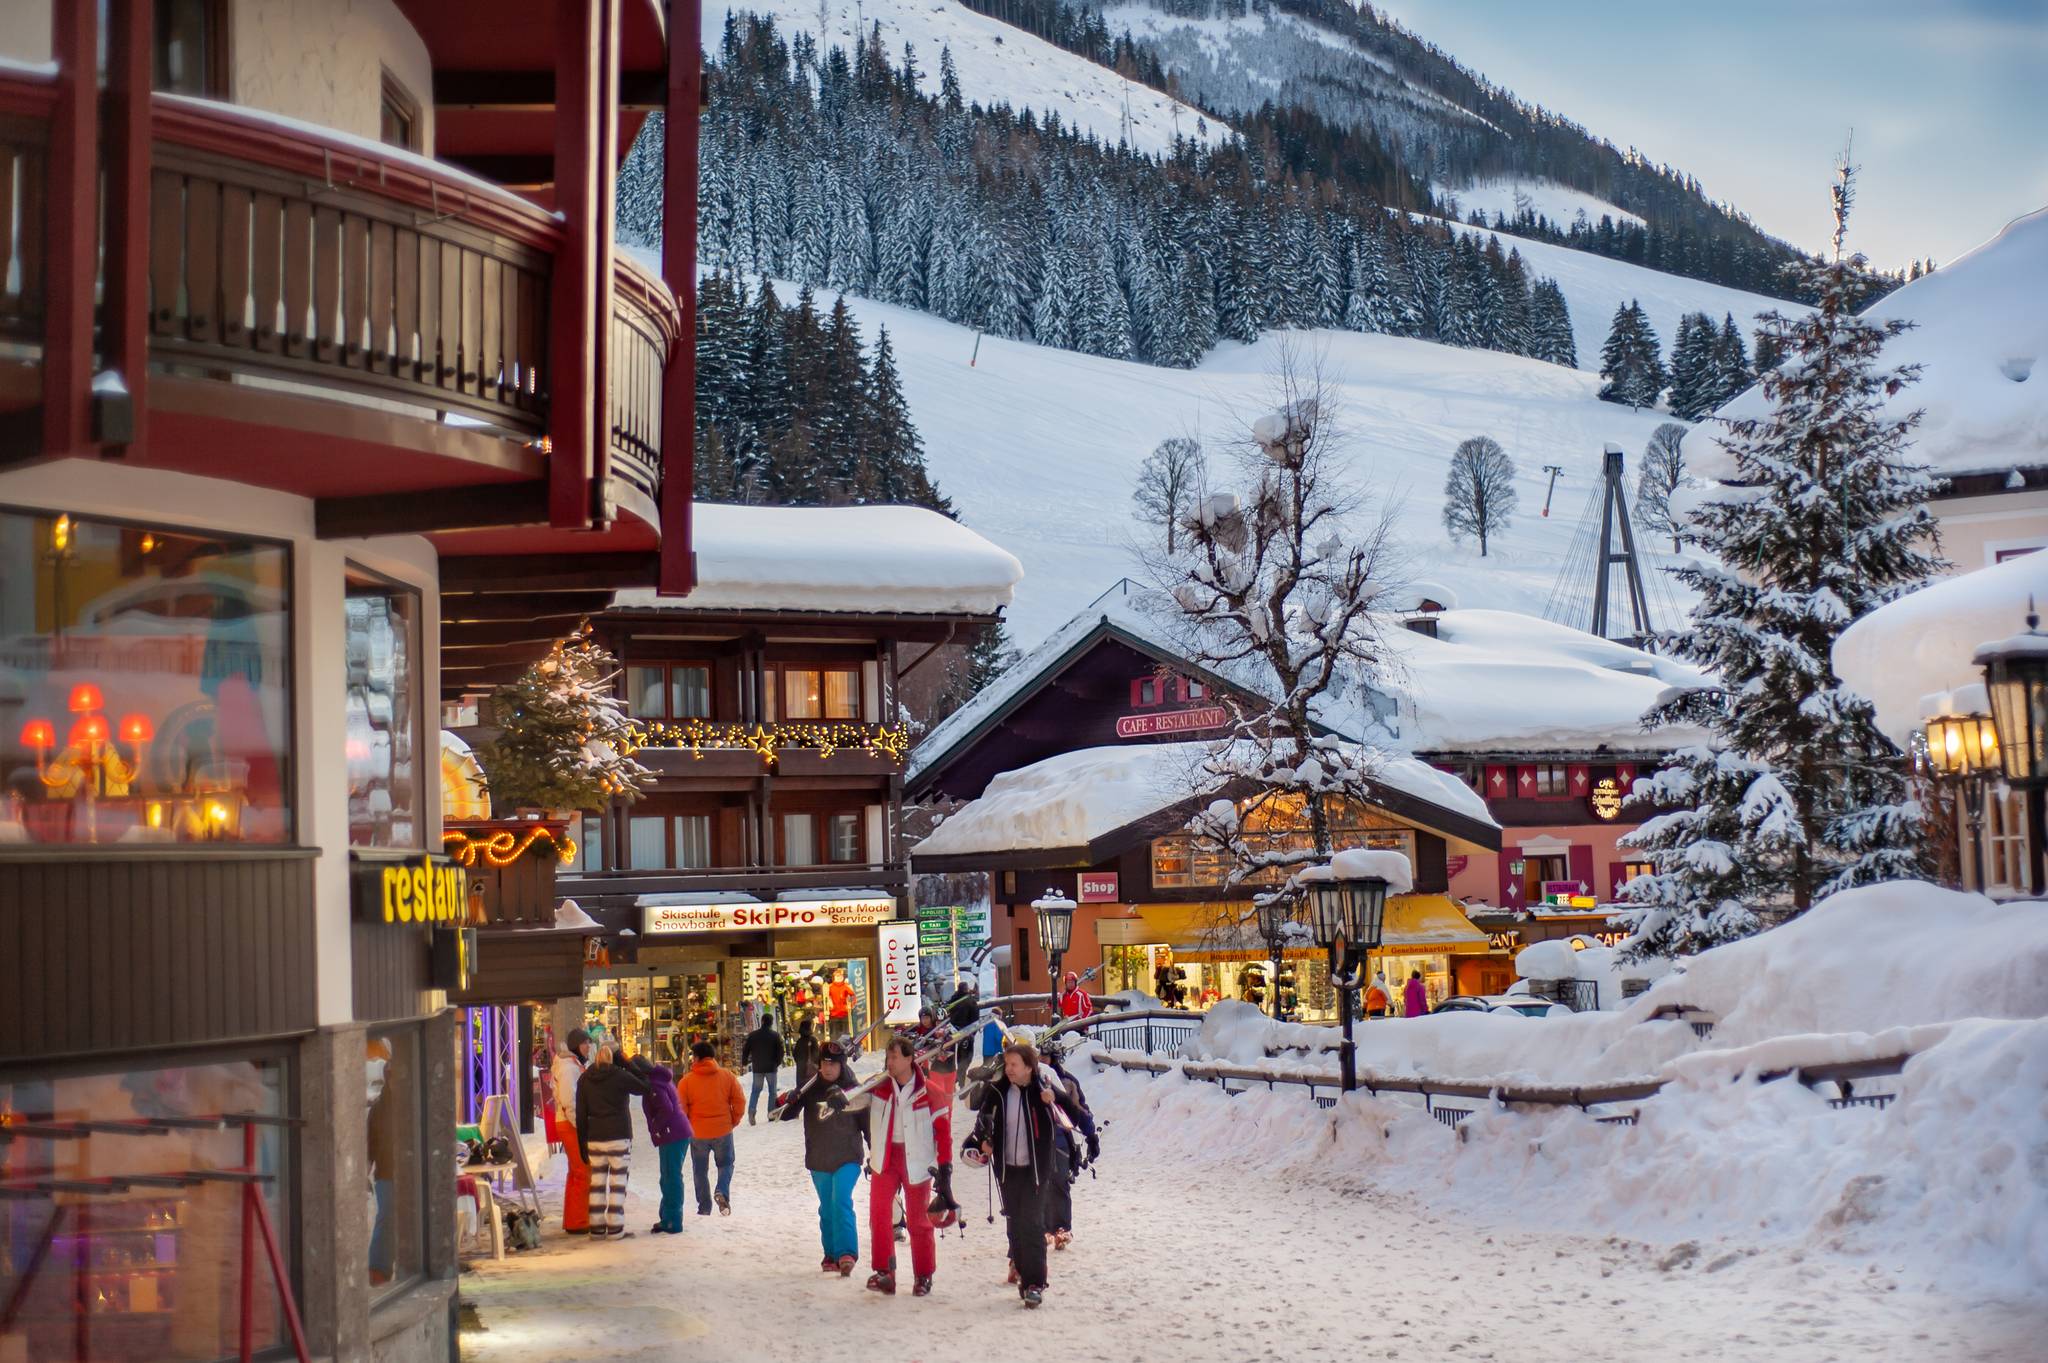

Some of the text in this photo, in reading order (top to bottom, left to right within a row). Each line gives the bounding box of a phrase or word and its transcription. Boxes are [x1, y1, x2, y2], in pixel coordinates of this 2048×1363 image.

[1123, 710, 1220, 734] CAFE RESTAURANT
[1083, 882, 1115, 895] Shop
[662, 908, 721, 920] Skischule
[820, 903, 890, 916] Sport Mode
[654, 919, 726, 931] Snowboard
[831, 914, 875, 924] Service
[885, 939, 901, 1010] SkiPro
[903, 943, 918, 996] Rent
